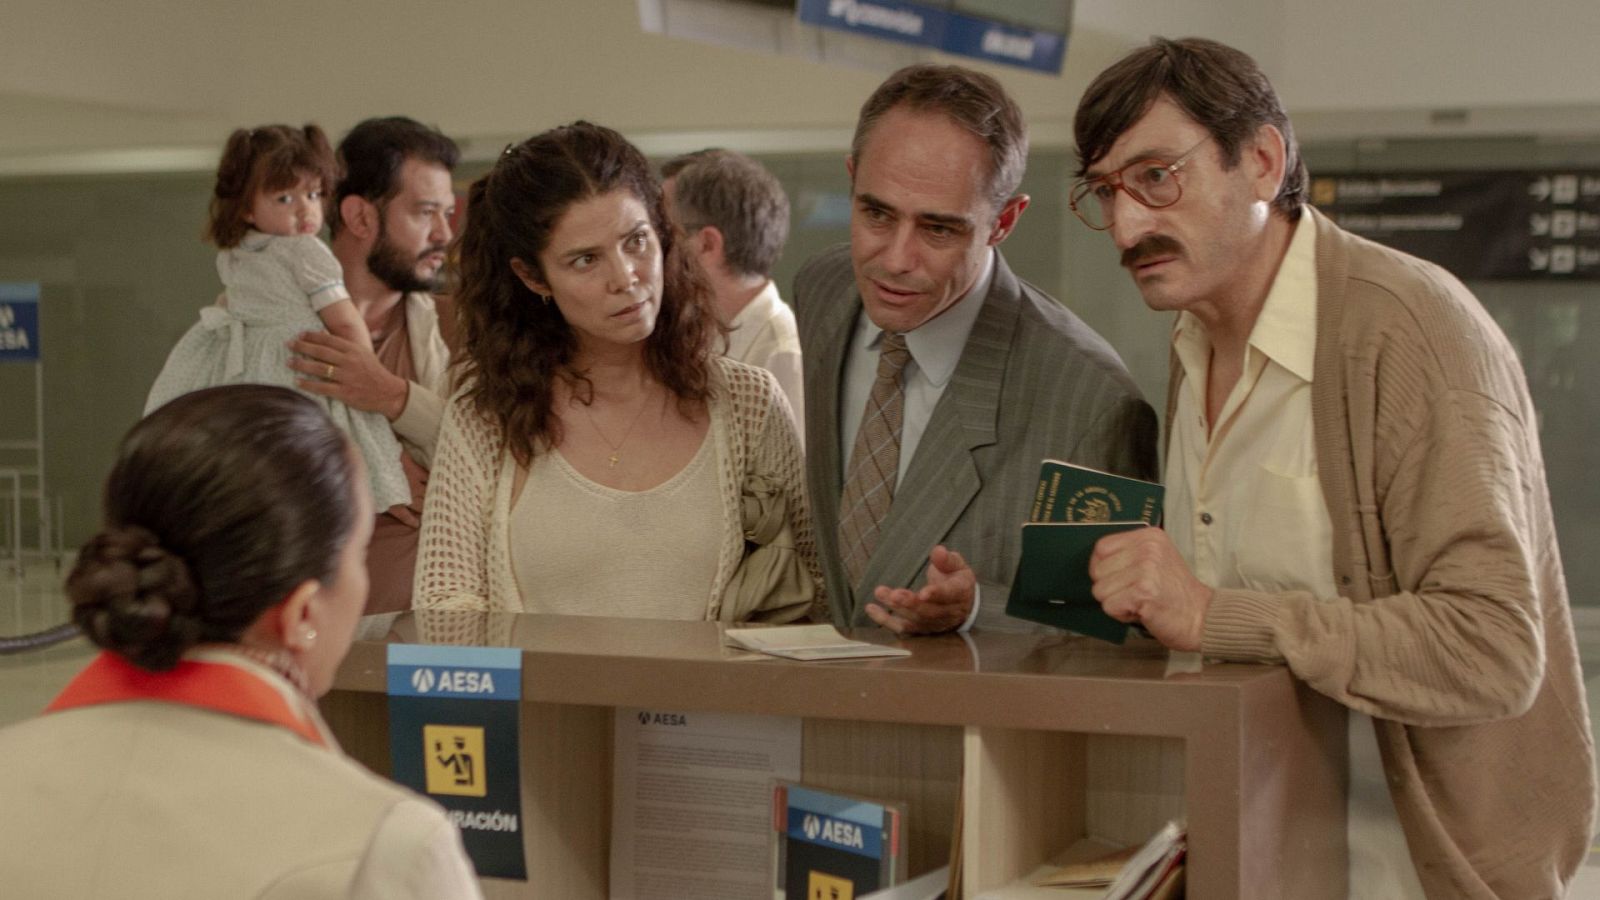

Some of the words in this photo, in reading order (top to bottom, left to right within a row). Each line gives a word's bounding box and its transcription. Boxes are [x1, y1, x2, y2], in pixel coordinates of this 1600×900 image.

[438, 671, 495, 693] AESA
[653, 713, 687, 726] AESA
[446, 810, 517, 832] RACIÓN
[821, 818, 864, 849] AESA
